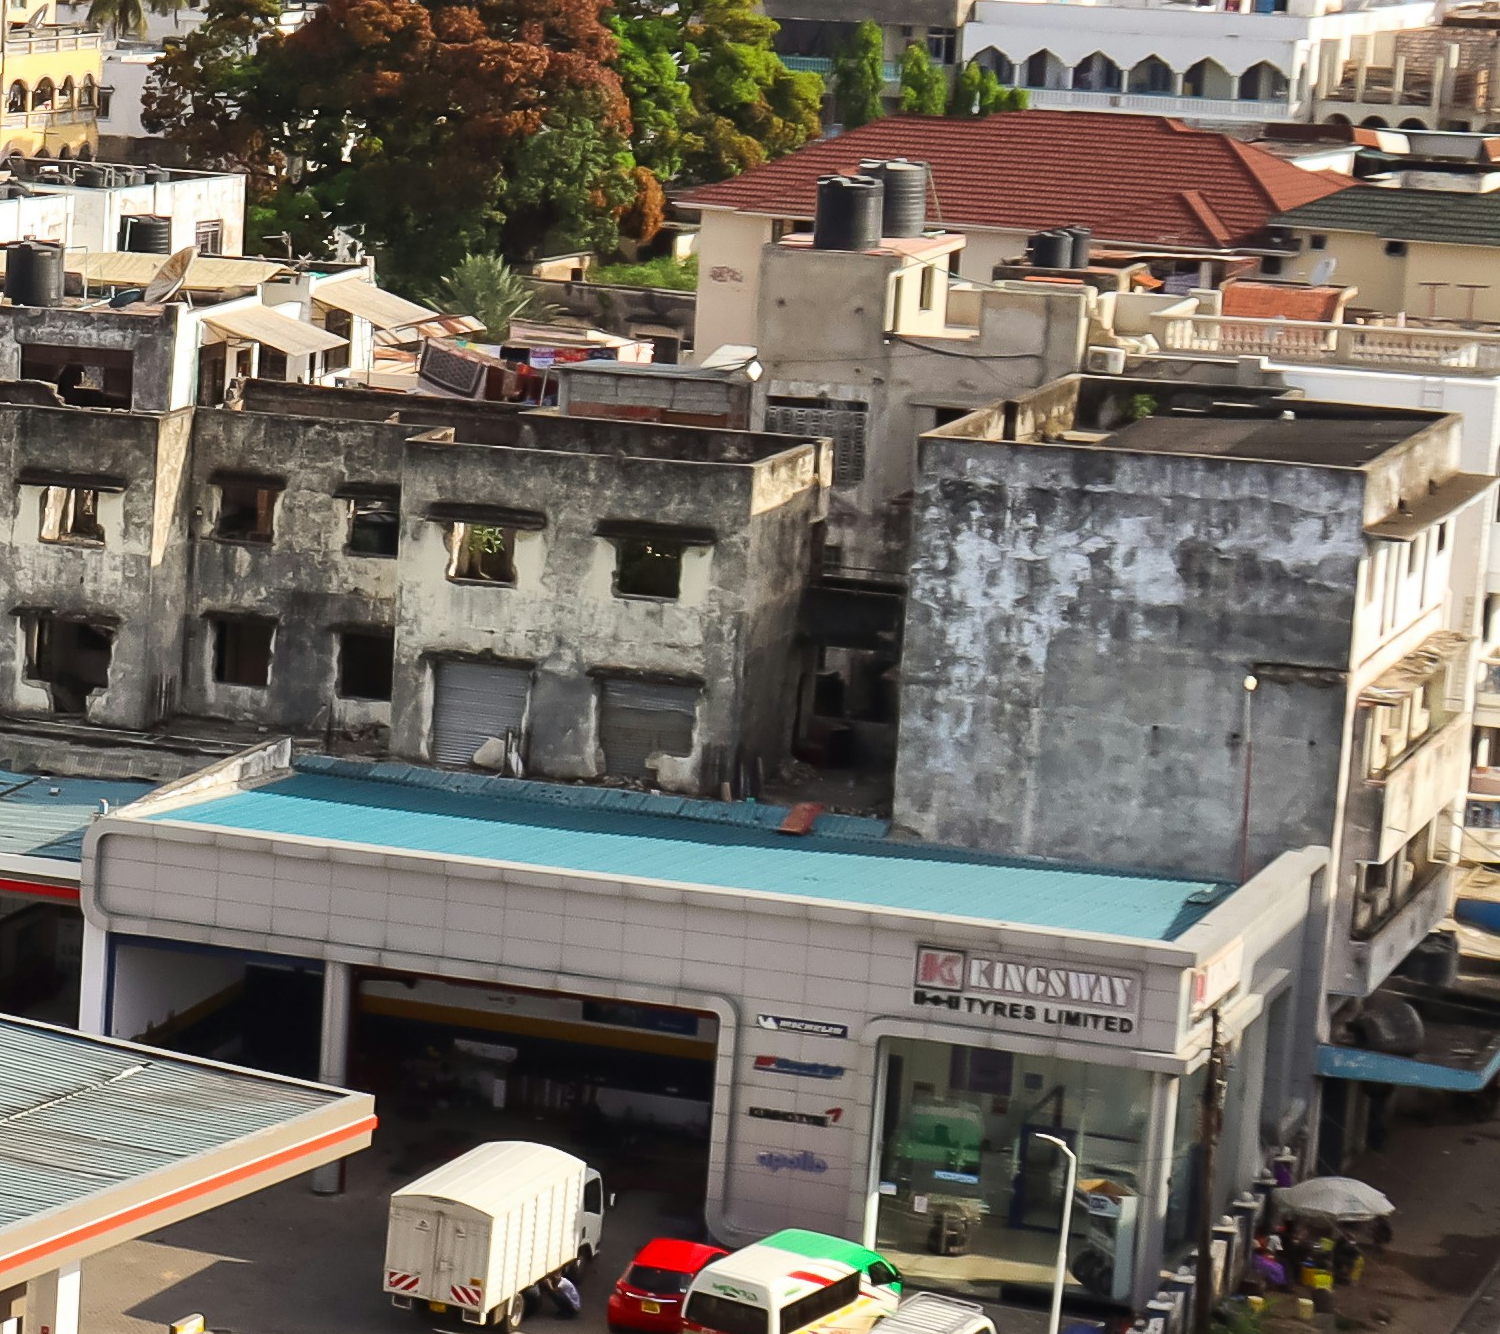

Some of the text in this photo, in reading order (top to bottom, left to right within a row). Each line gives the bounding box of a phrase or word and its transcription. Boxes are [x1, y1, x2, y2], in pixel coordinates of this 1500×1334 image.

[969, 957, 1134, 1008] KINGSWAY
[964, 997, 1134, 1034] TYRES LIMITED
